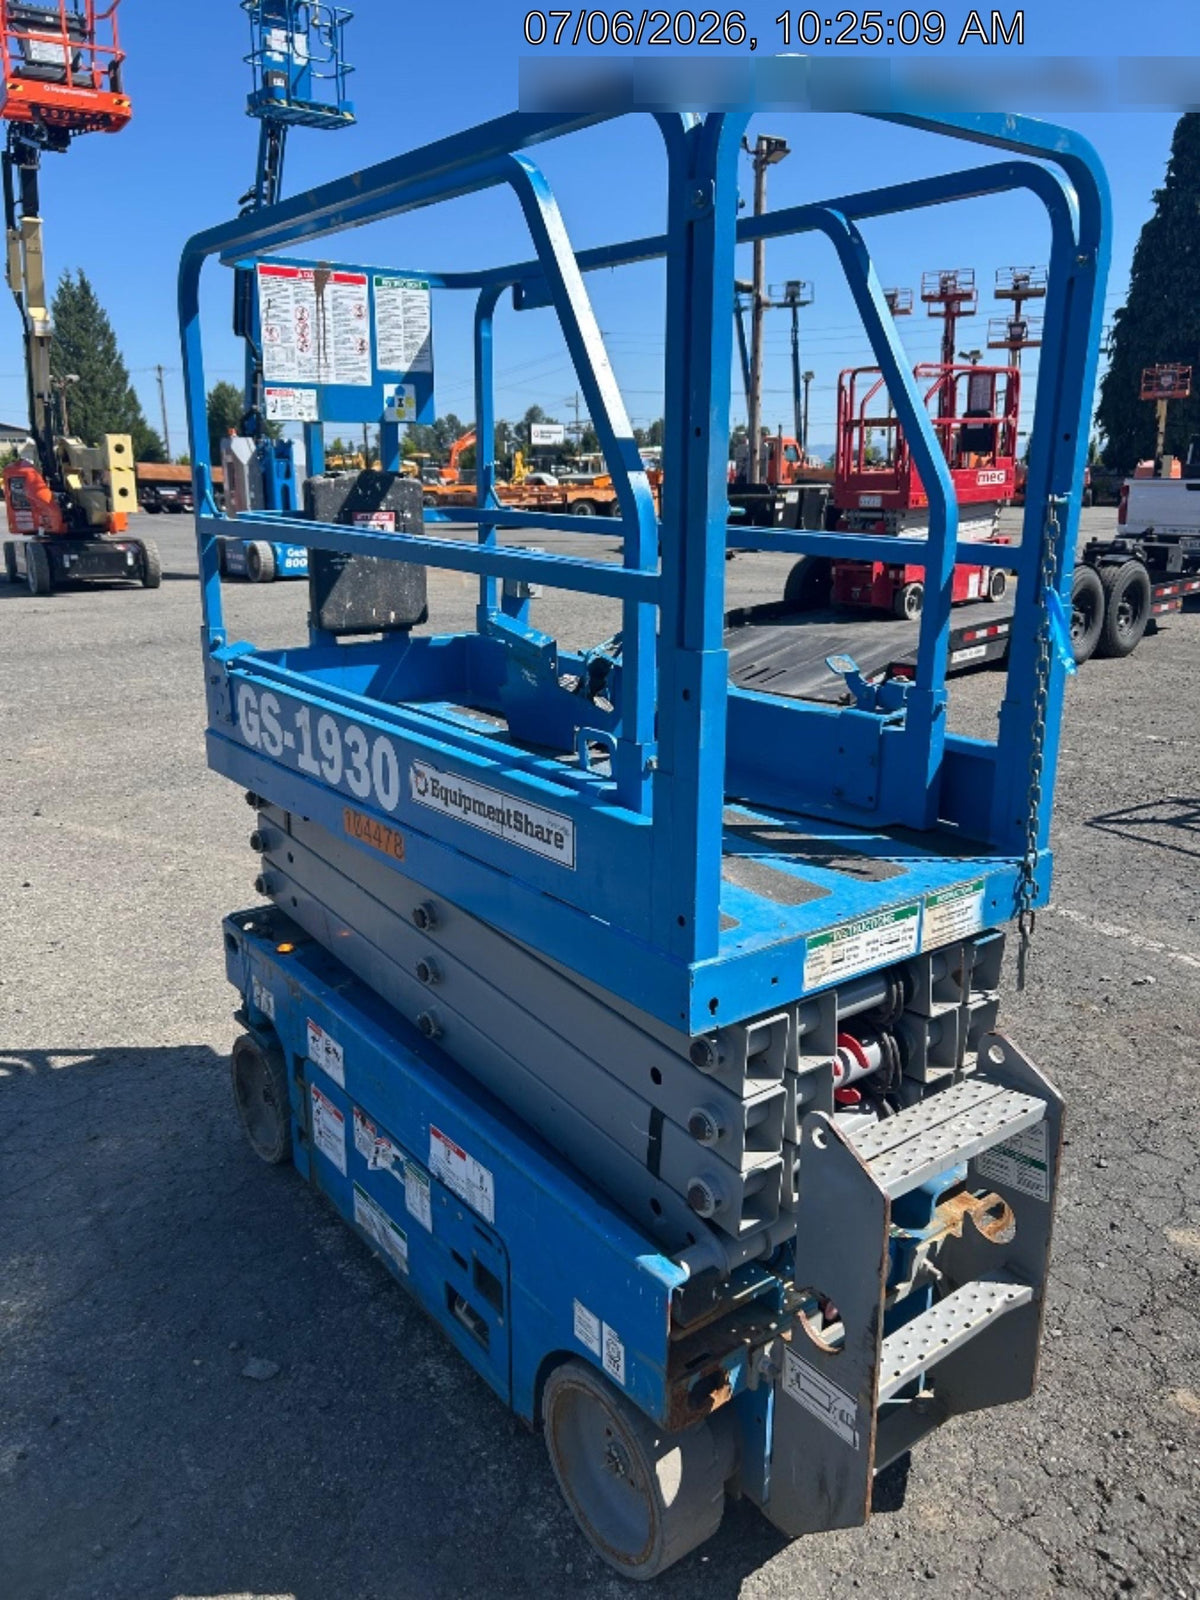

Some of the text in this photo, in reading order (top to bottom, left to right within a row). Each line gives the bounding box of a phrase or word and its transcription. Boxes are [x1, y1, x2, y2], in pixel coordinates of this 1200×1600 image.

[977, 472, 1005, 483] mec
[237, 683, 400, 812] GS-1930
[430, 777, 565, 850] EquipmentShare
